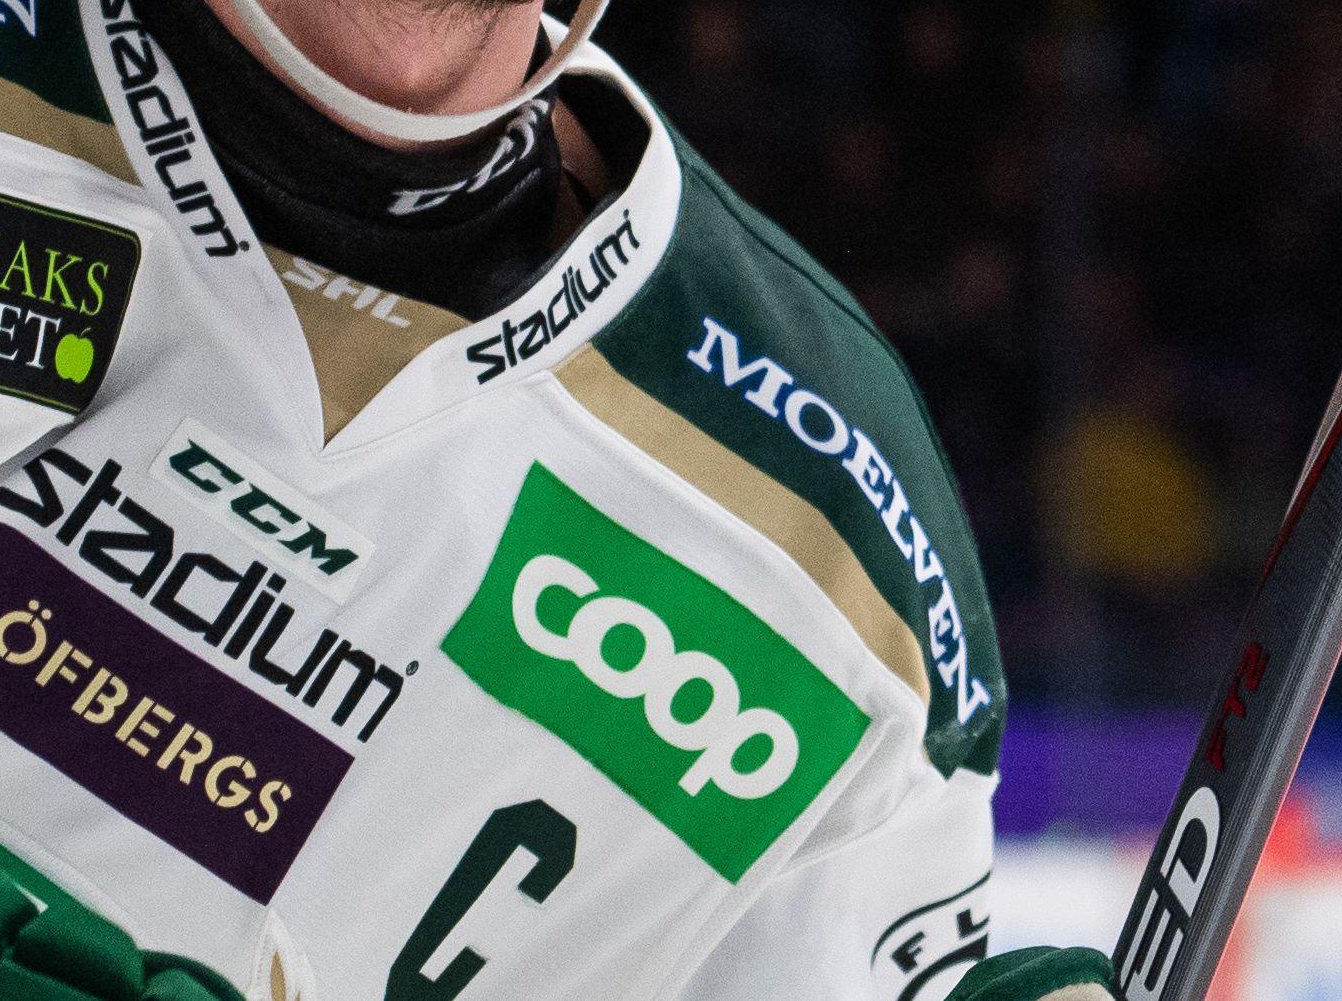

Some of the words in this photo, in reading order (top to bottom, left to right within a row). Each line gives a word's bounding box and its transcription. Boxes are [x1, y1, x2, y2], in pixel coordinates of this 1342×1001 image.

[283, 257, 410, 327] SHL
[168, 439, 359, 576] CCM
[687, 316, 991, 726] MOELVEN
[512, 554, 799, 799] coop
[384, 798, 577, 1001] C
